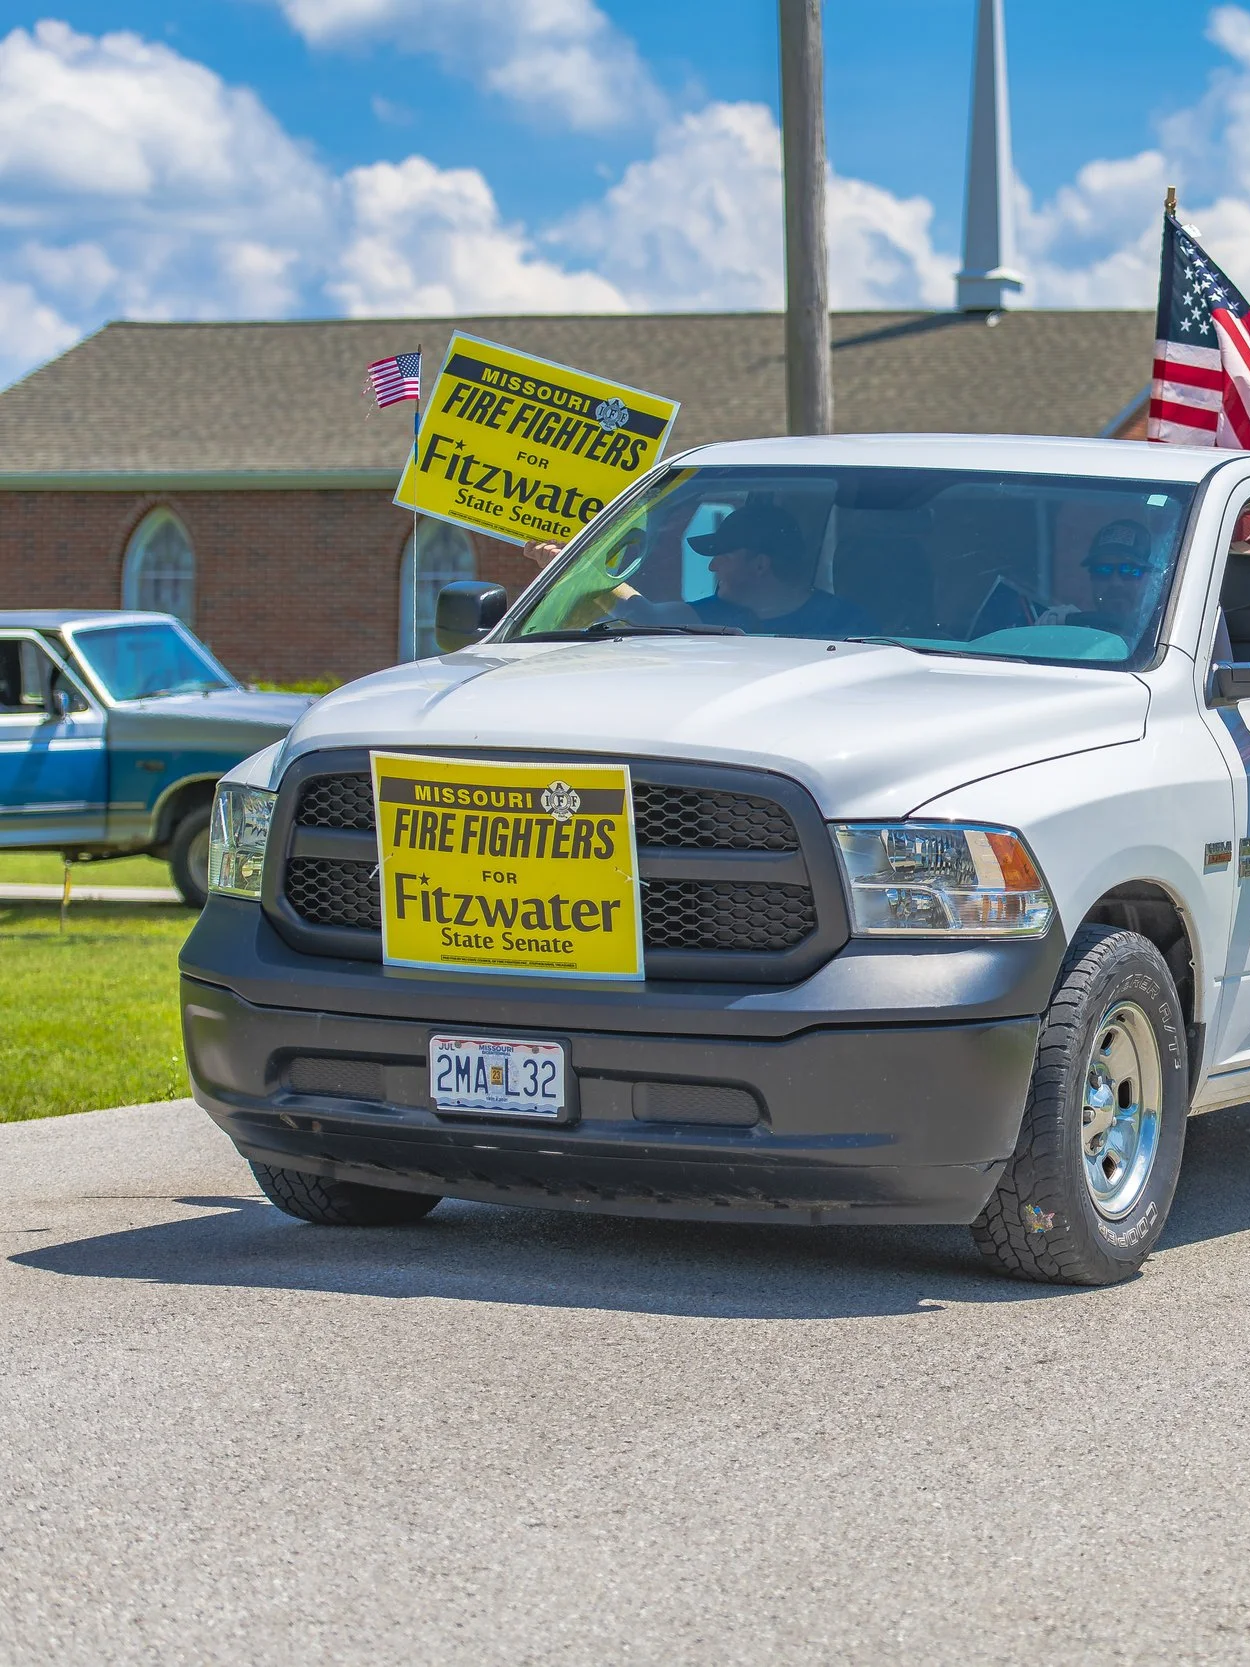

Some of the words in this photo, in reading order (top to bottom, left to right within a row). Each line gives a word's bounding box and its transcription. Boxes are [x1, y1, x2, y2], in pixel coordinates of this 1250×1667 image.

[481, 367, 591, 413] MISSOURI
[441, 382, 514, 432] FIRE
[506, 402, 648, 472] FIGHTERS
[516, 450, 550, 471] FOR
[419, 433, 604, 525] Fitzwate
[454, 488, 504, 517] State
[509, 505, 571, 539] Senate
[414, 785, 532, 809] MISSOURI
[393, 807, 456, 853] FIRE
[461, 814, 616, 860] FIGHTERS
[482, 870, 518, 885] FOR
[394, 872, 622, 933] Fitzwater
[441, 927, 495, 951] State
[502, 931, 574, 954] Senate
[438, 1043, 456, 1051] JUL
[478, 1044, 514, 1052] MISSOURI
[437, 1054, 489, 1094] 2MA
[504, 1058, 557, 1099] L32
[492, 1070, 501, 1080] 23
